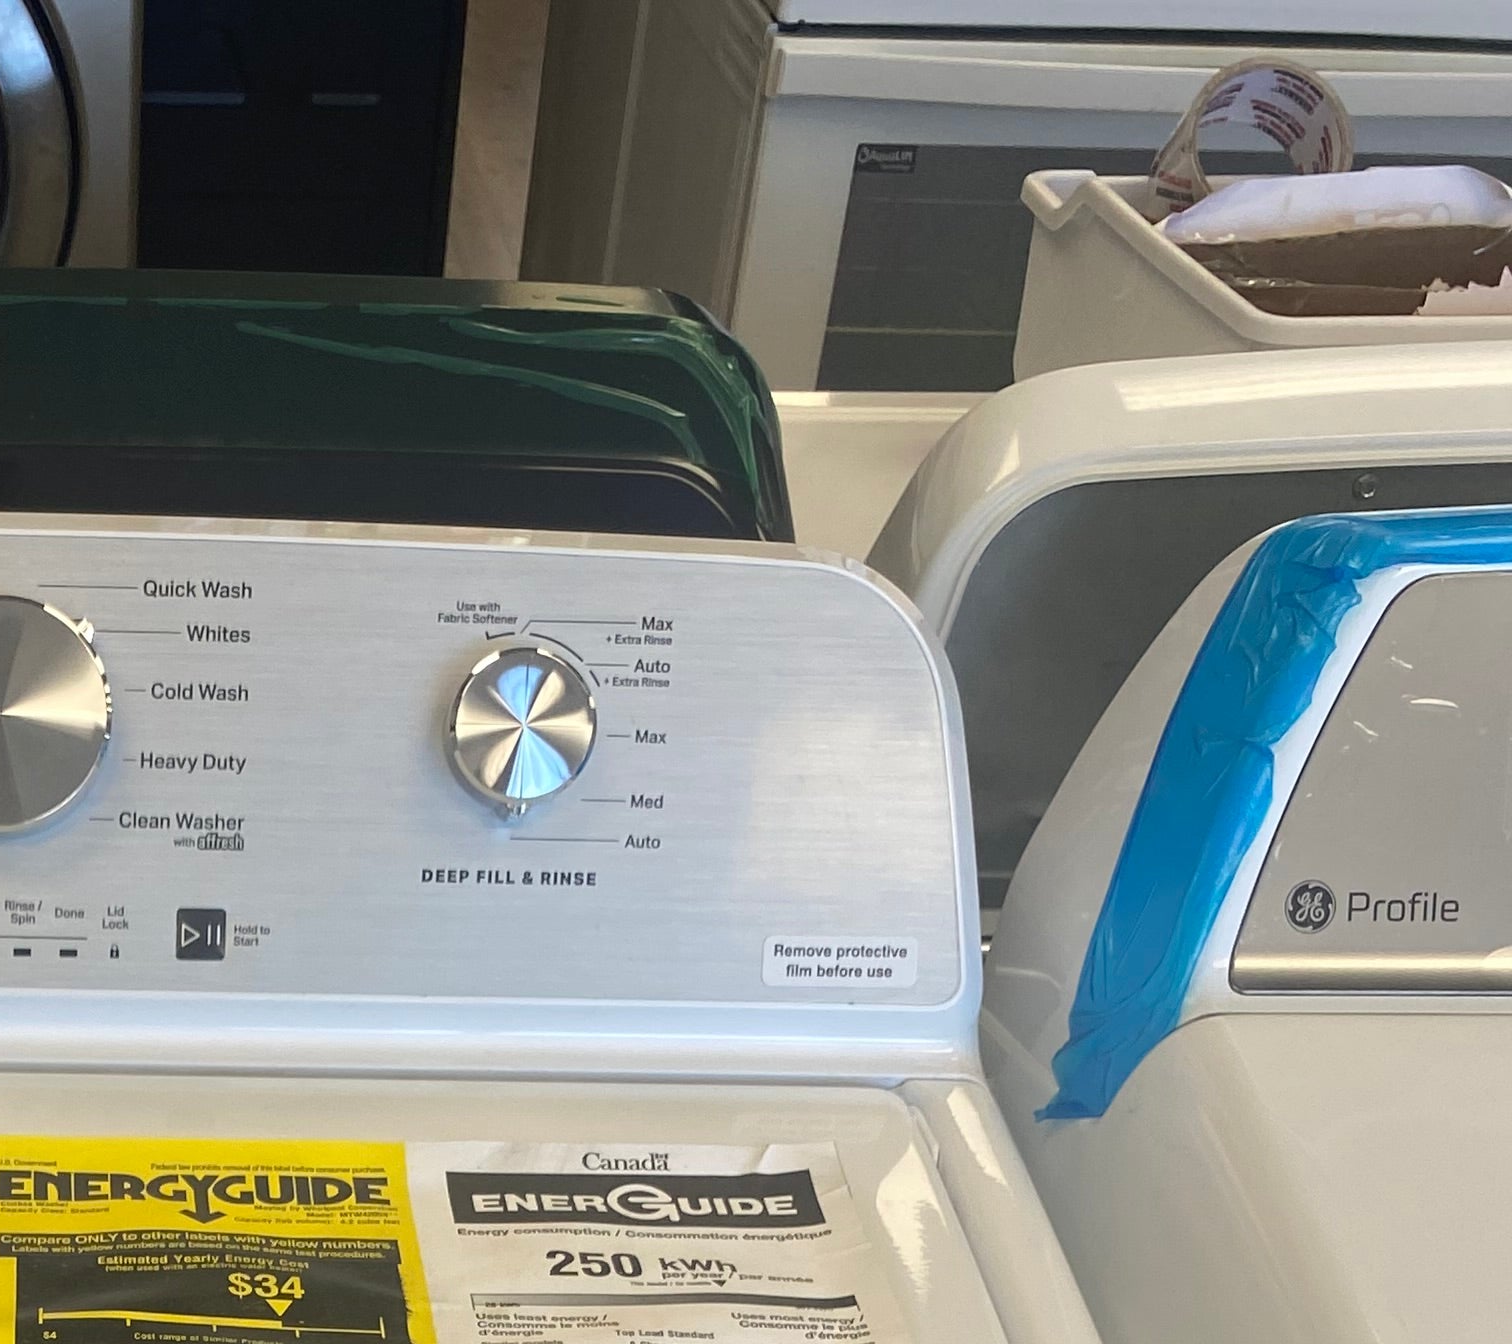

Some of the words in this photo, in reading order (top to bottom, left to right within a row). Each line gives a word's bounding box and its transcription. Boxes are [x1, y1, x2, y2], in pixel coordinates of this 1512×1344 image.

[143, 580, 196, 598] Quick
[202, 581, 252, 599] Wash
[456, 602, 476, 612] Use
[478, 602, 501, 612] with
[438, 614, 470, 624] Fabric
[472, 614, 518, 625] Softener
[642, 617, 673, 631] Max
[186, 625, 251, 643] Whites
[614, 634, 642, 645] Extra
[644, 636, 672, 646] Rinse
[634, 660, 670, 674] Auto
[612, 677, 640, 687] Extra
[642, 678, 670, 688] Rinse
[150, 683, 193, 700] Cold
[199, 684, 249, 701] Wash
[635, 730, 667, 744] Max
[140, 752, 198, 773] Heavy
[203, 754, 246, 774] Duty
[630, 796, 663, 808] Med
[119, 812, 171, 829] Clean
[176, 813, 245, 830] Washer
[174, 838, 195, 848] with
[624, 835, 661, 849] Auto
[421, 869, 470, 883] DEEP
[476, 870, 516, 884] FILL
[522, 872, 534, 884] &
[540, 872, 597, 886] RINSE
[55, 907, 85, 919] Done
[107, 906, 125, 917] Lid
[1347, 892, 1459, 922] Profile
[11, 914, 35, 925] Spin
[102, 918, 129, 929] Lock
[234, 925, 258, 935] Hold
[260, 926, 270, 935] to
[234, 936, 260, 947] Start
[773, 944, 832, 958] Remove
[836, 945, 908, 960] protective
[786, 965, 812, 977] film
[817, 965, 862, 977] before
[867, 968, 892, 977] use
[582, 1152, 669, 1171] Canada
[472, 1183, 798, 1221] ENERGUIDE
[1, 1235, 71, 1245] Compare
[75, 1233, 118, 1244] ONLY
[122, 1233, 137, 1241] to
[142, 1232, 179, 1241] other
[186, 1232, 229, 1242] labels
[234, 1235, 266, 1244] with
[270, 1239, 318, 1251] yellow
[323, 1240, 395, 1249] numbers.
[98, 1256, 168, 1264] Estimated
[173, 1252, 219, 1265] Yearly
[225, 1254, 274, 1267] Energy
[279, 1260, 309, 1269] Cost
[546, 1250, 642, 1277] 250
[659, 1258, 737, 1272] kWh
[228, 1272, 305, 1299] $34
